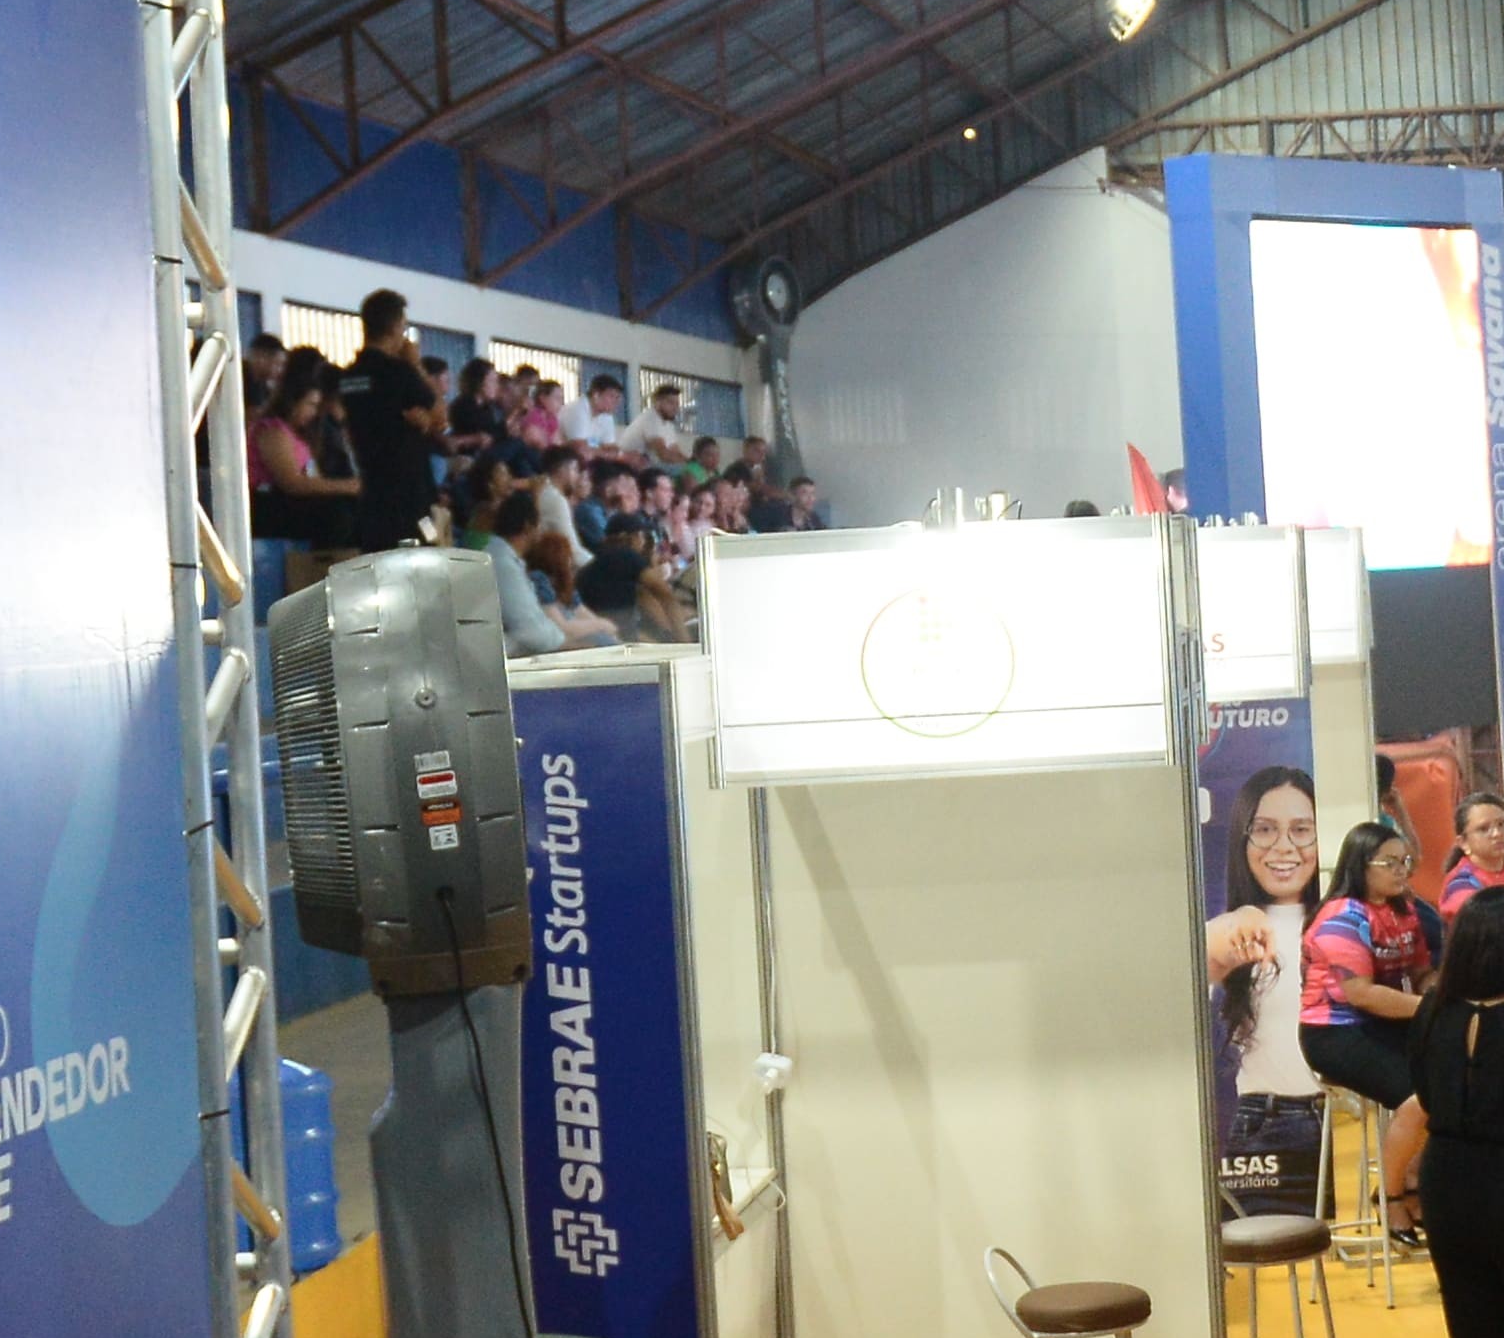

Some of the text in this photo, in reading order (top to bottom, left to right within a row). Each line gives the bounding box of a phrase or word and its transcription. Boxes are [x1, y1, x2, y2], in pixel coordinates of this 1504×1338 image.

[539, 752, 605, 1204] SEBRAE Startups
[1218, 1154, 1280, 1177] LSAS
